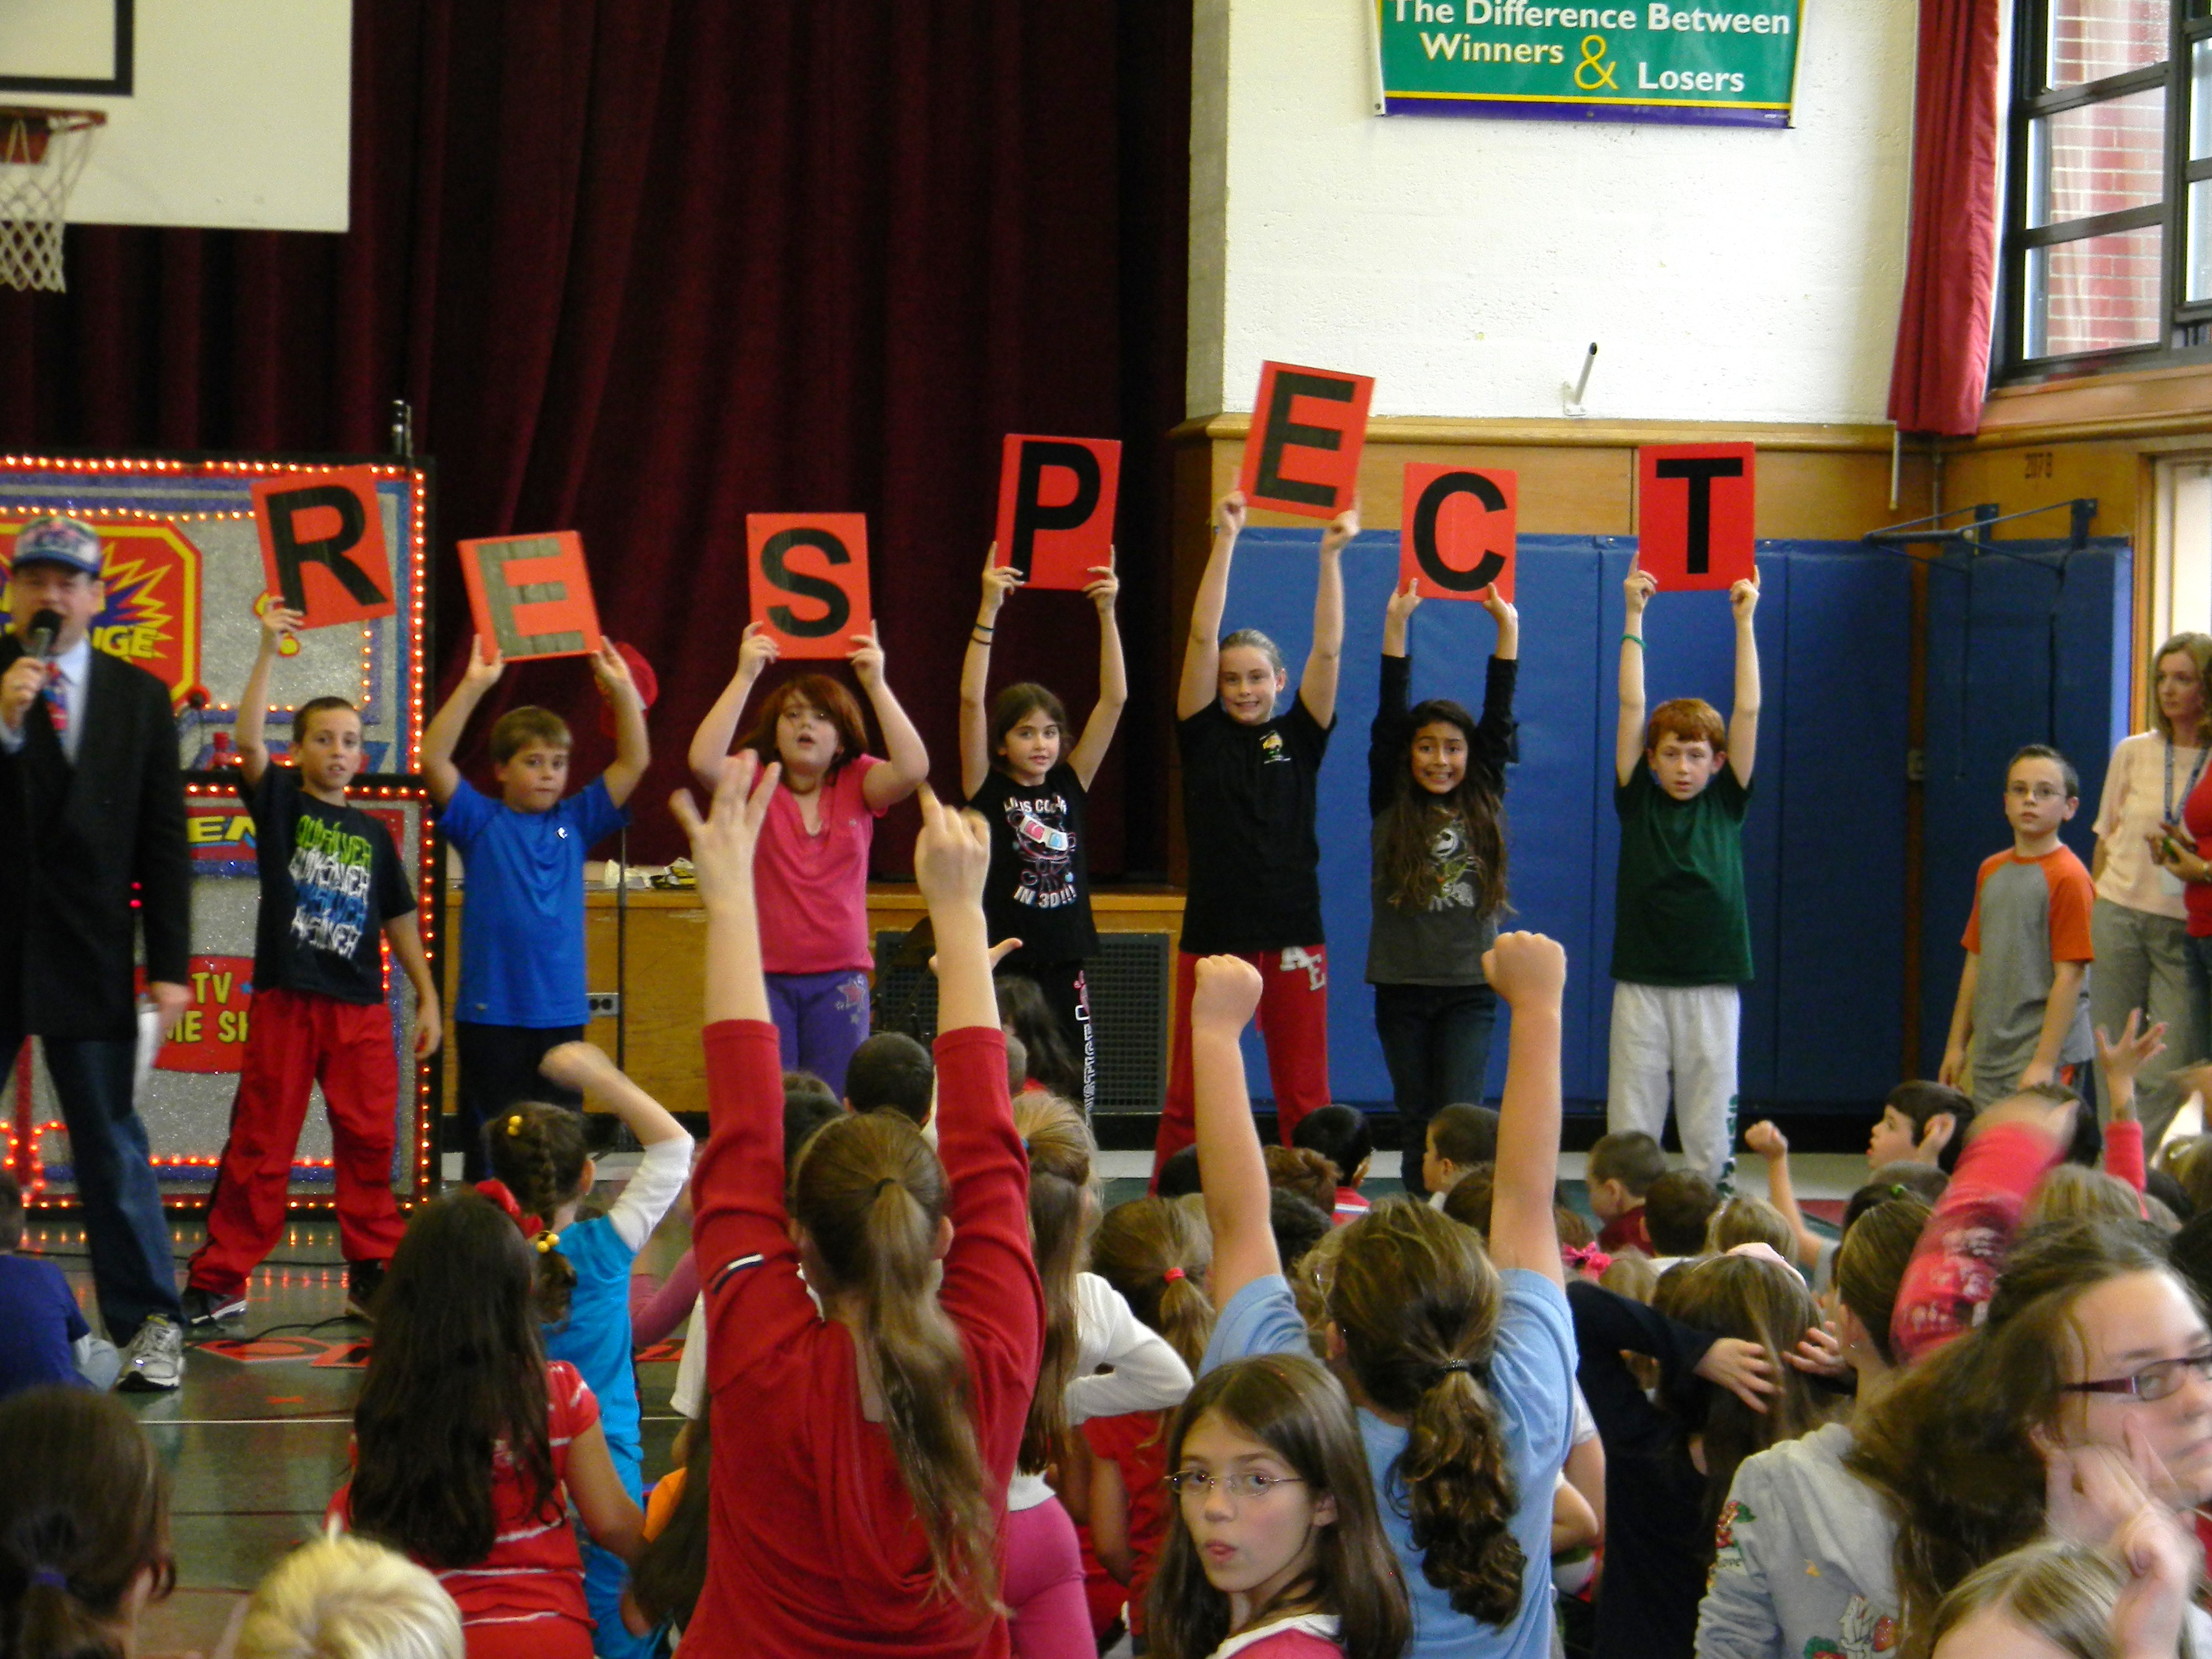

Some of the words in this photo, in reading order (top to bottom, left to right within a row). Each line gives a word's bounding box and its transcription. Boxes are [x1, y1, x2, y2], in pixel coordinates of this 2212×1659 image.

[1392, 0, 1454, 23] The
[1465, 0, 1636, 29] Difference
[1647, 2, 1790, 34] Between
[1419, 32, 1564, 64] Winners
[1574, 34, 1619, 90] &
[1638, 61, 1744, 93] Losers
[1255, 371, 1356, 508] E
[265, 485, 388, 615] R
[1010, 441, 1101, 582] P
[1413, 472, 1507, 592] C
[1656, 457, 1743, 574] T
[477, 538, 587, 658] E
[760, 527, 851, 638] S
[1013, 885, 1036, 905] IN
[191, 972, 232, 1004] TV
